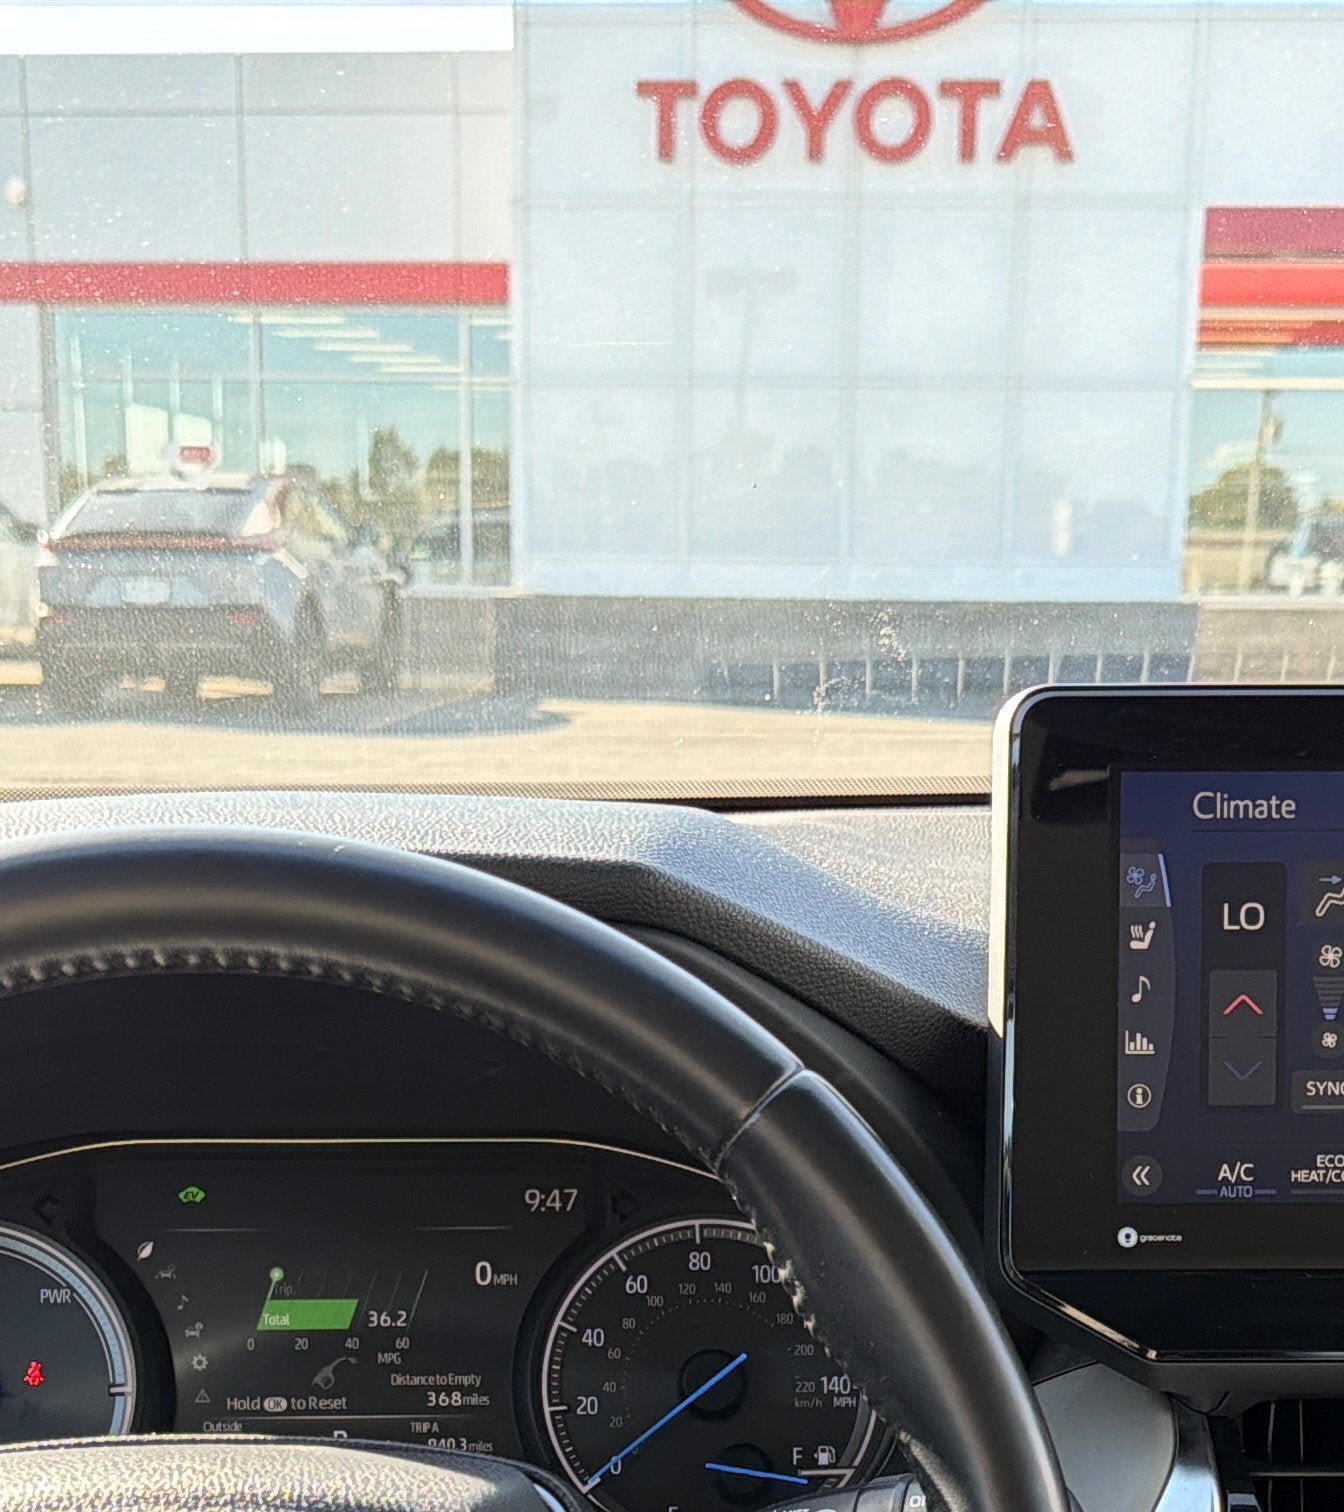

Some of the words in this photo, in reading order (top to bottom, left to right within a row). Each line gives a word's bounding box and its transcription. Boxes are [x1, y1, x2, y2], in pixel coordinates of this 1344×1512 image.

[635, 78, 1075, 164] TOYOTA
[1192, 791, 1297, 820] Climate
[1222, 903, 1266, 931] LO
[1218, 1161, 1255, 1182] A/C
[1220, 1185, 1253, 1198] AUTO
[524, 1189, 578, 1212] 9:47
[688, 1252, 711, 1271] 80
[474, 1261, 492, 1286] 0
[494, 1273, 518, 1286] MPH
[752, 1264, 781, 1283] 100
[625, 1275, 648, 1295] 60
[678, 1283, 696, 1295] 120
[713, 1282, 732, 1294] 140
[40, 1288, 71, 1304] PWR
[646, 1295, 664, 1308] 100
[748, 1291, 766, 1303] 160
[263, 1313, 290, 1326] Total
[368, 1311, 407, 1327] 36.2
[622, 1317, 636, 1330] 80
[776, 1312, 794, 1325] 180
[295, 1338, 309, 1350] 20
[345, 1338, 359, 1350] 40
[395, 1337, 410, 1350] 60
[581, 1328, 605, 1346] 40
[607, 1347, 621, 1360] 60
[794, 1344, 814, 1357] 200
[377, 1353, 401, 1365] MPG
[391, 1373, 435, 1386] Distance
[436, 1375, 447, 1386] to
[448, 1373, 482, 1388] Empty
[603, 1381, 617, 1393] 40
[796, 1381, 816, 1393] 220
[819, 1375, 852, 1394] 140
[227, 1396, 261, 1411] Hold
[291, 1399, 306, 1410] to
[309, 1396, 348, 1410] Reset
[426, 1392, 462, 1407] 368
[462, 1395, 490, 1406] miles
[576, 1397, 598, 1415] 20
[794, 1396, 822, 1408] km/h
[833, 1397, 856, 1408] MPH
[203, 1421, 243, 1432] Outside
[411, 1422, 431, 1433] TRIP
[431, 1422, 440, 1433] A
[609, 1416, 623, 1428] 20
[793, 1447, 803, 1465] F
